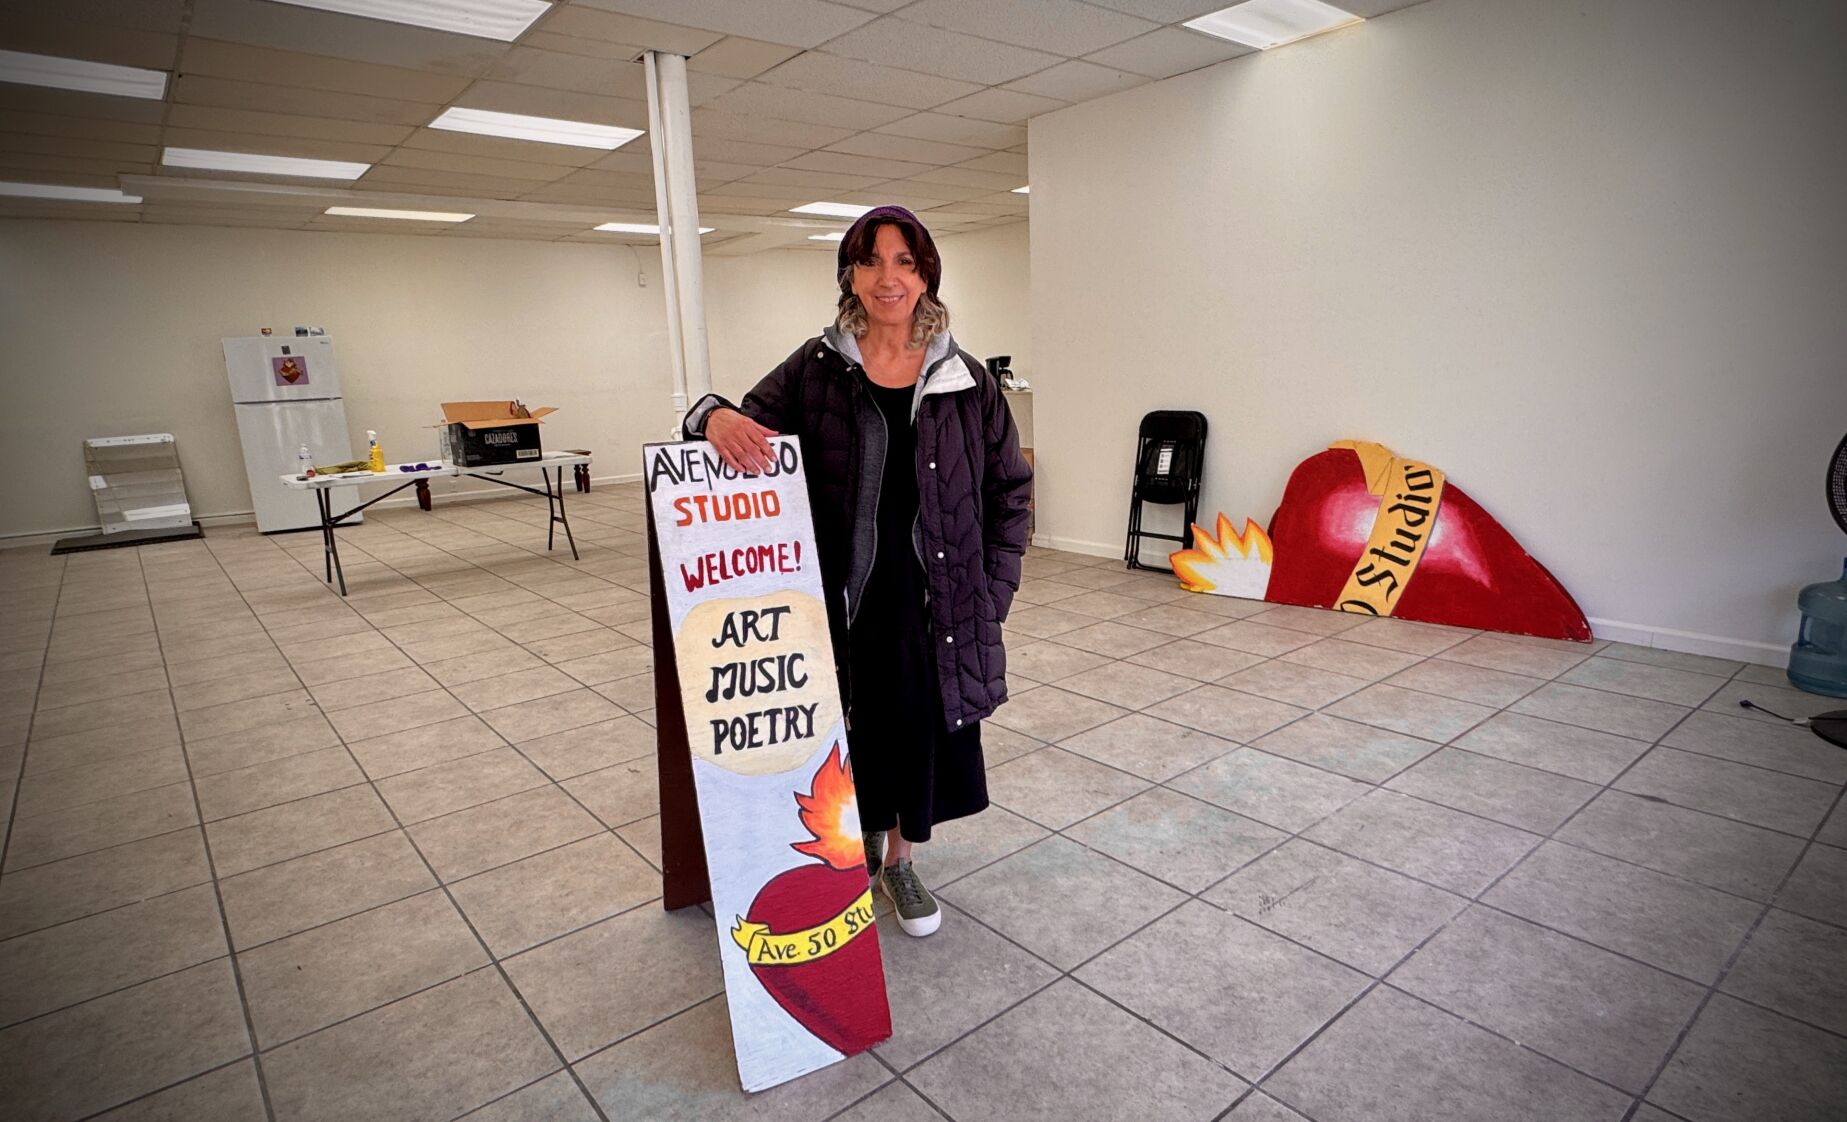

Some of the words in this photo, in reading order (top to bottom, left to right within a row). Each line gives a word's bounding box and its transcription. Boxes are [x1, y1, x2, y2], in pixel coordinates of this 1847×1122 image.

[650, 447, 759, 491] AVENU
[673, 490, 781, 527] STUDIO
[680, 540, 802, 593] WELCOME!
[712, 605, 791, 648] ART
[705, 652, 808, 703] MUSIC
[709, 702, 819, 755] POETRY
[757, 937, 801, 962] Ave.
[807, 927, 836, 956] 50
